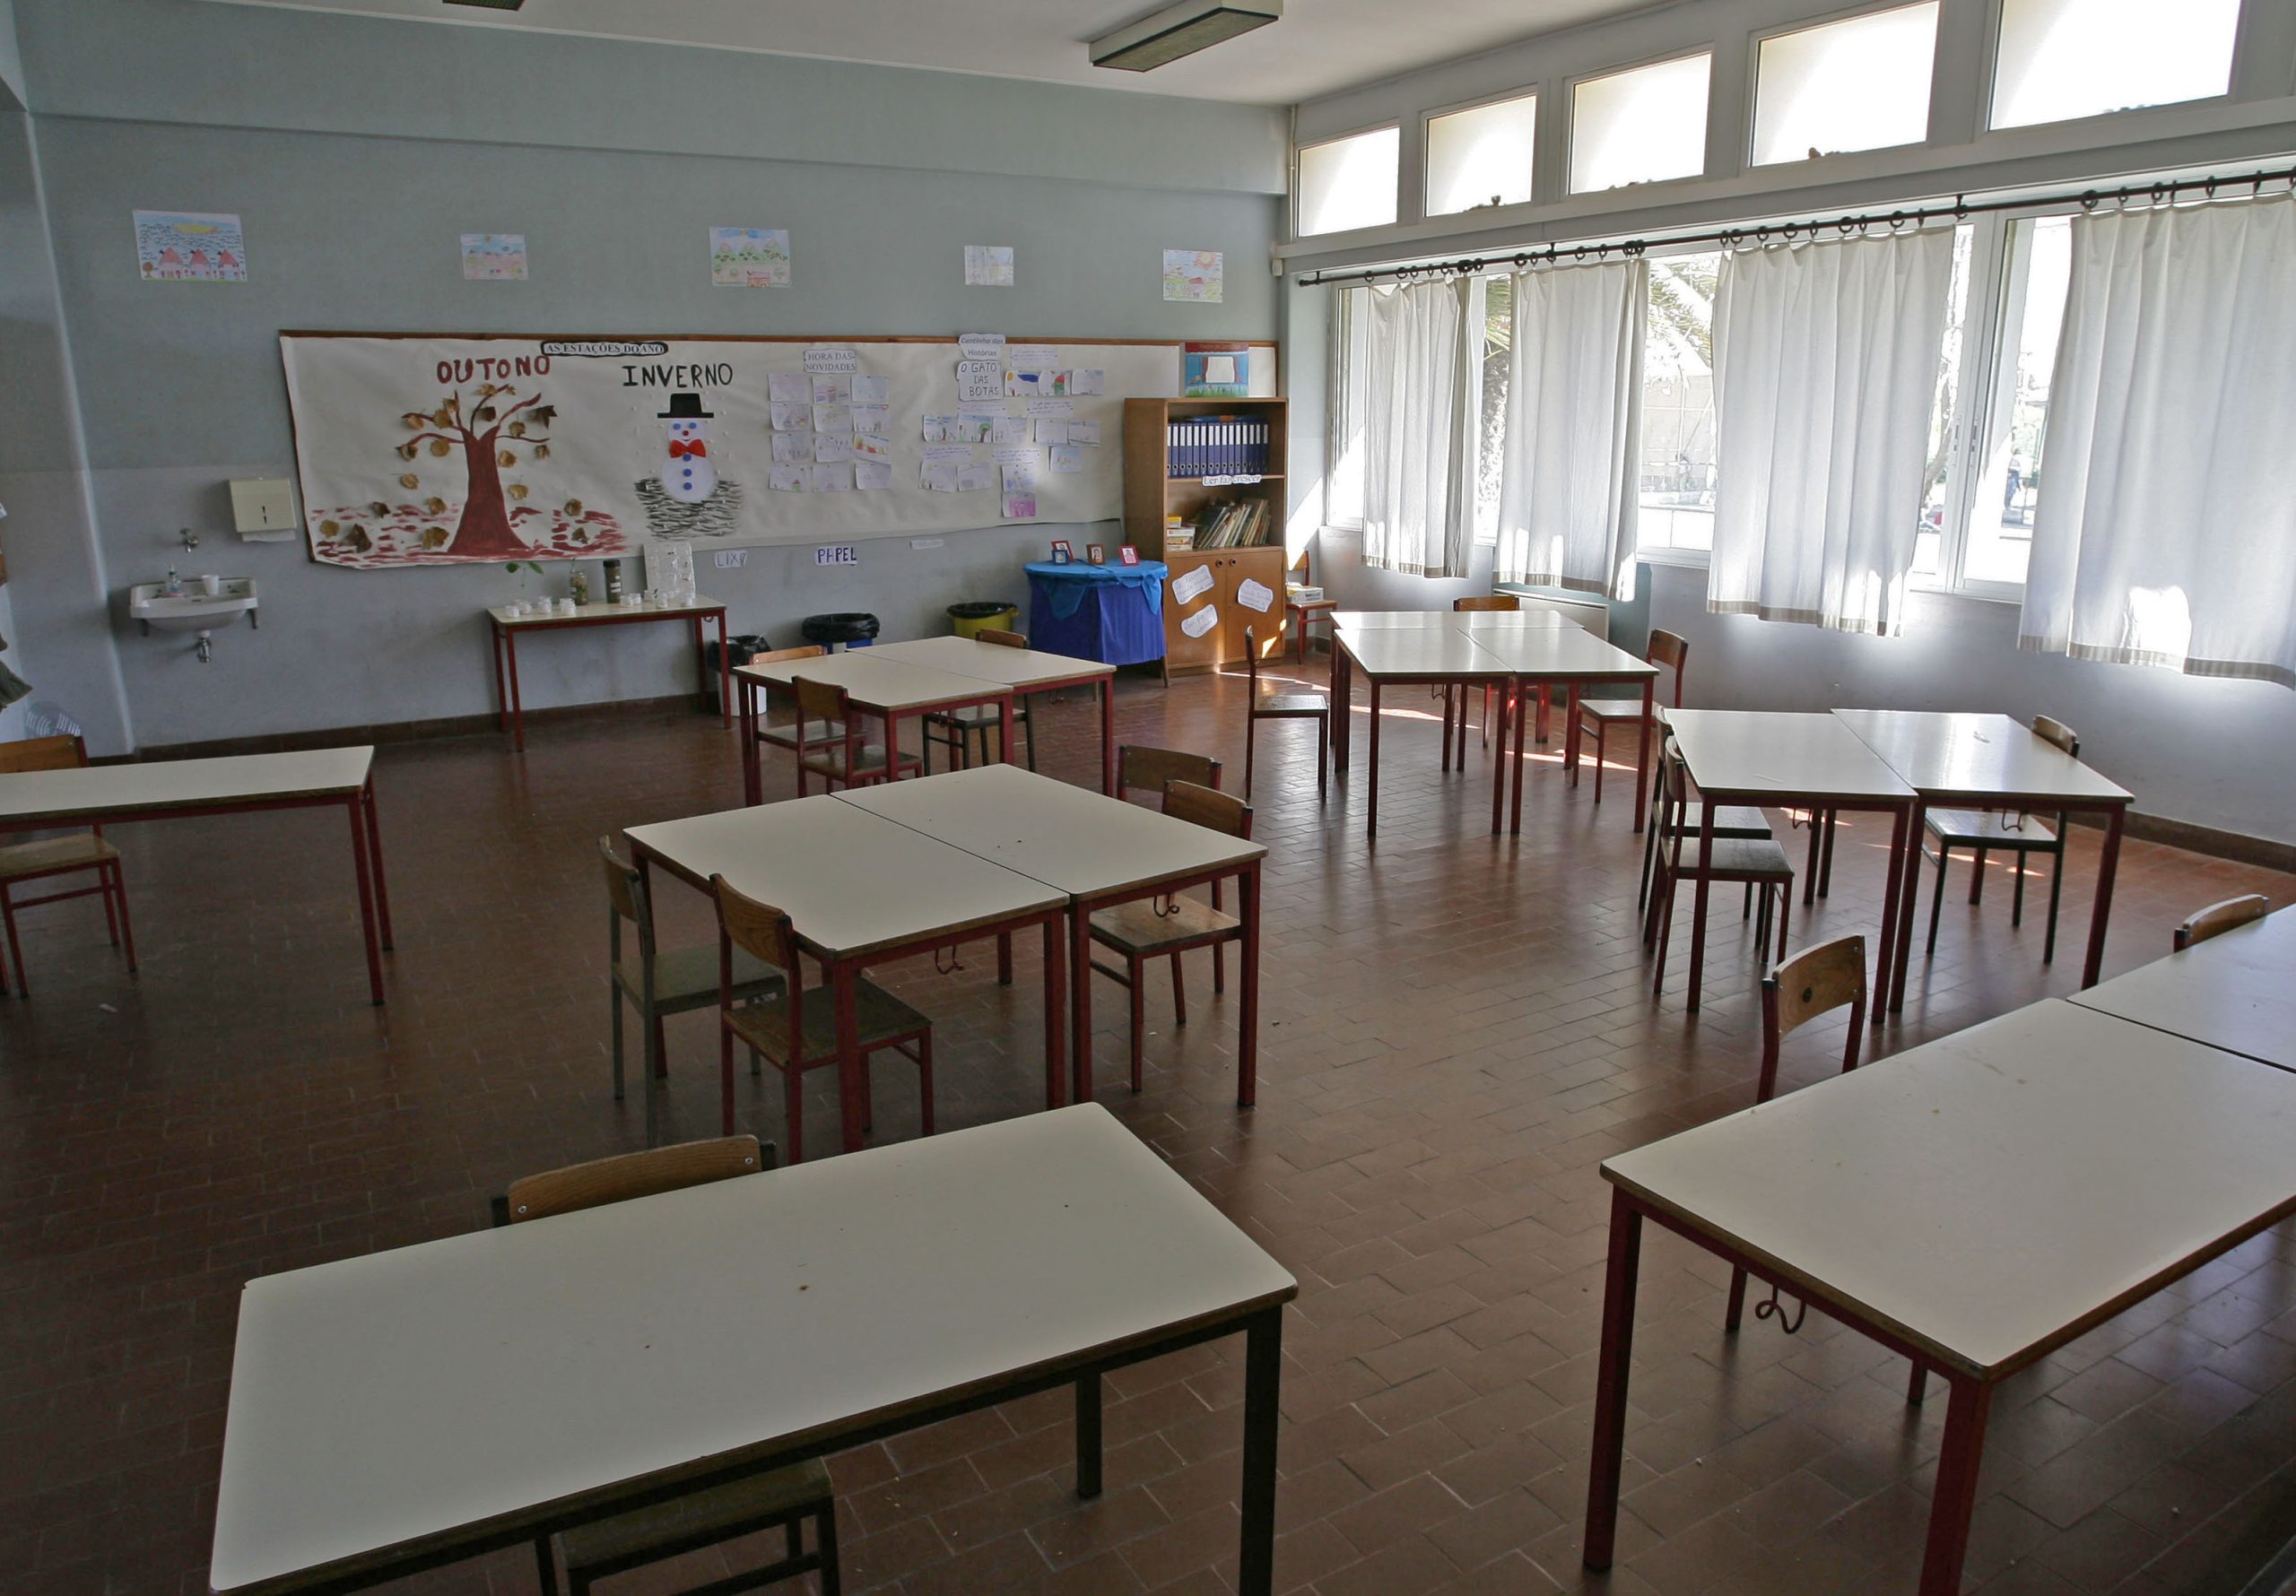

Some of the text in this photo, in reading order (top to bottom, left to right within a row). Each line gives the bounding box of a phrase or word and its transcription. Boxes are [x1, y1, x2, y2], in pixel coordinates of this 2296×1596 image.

[547, 343, 664, 354] AS ESTAÇÕES DO ANO
[969, 348, 997, 357] Histórias
[808, 352, 852, 360] HORA DAS
[437, 355, 551, 384] OUTONO
[805, 363, 856, 371] NOVIDADES
[961, 362, 997, 372] O GATO
[622, 363, 733, 387] INVERNO
[974, 375, 988, 384] DAS
[970, 386, 998, 396] BOTAS
[817, 547, 857, 564] PAPEL
